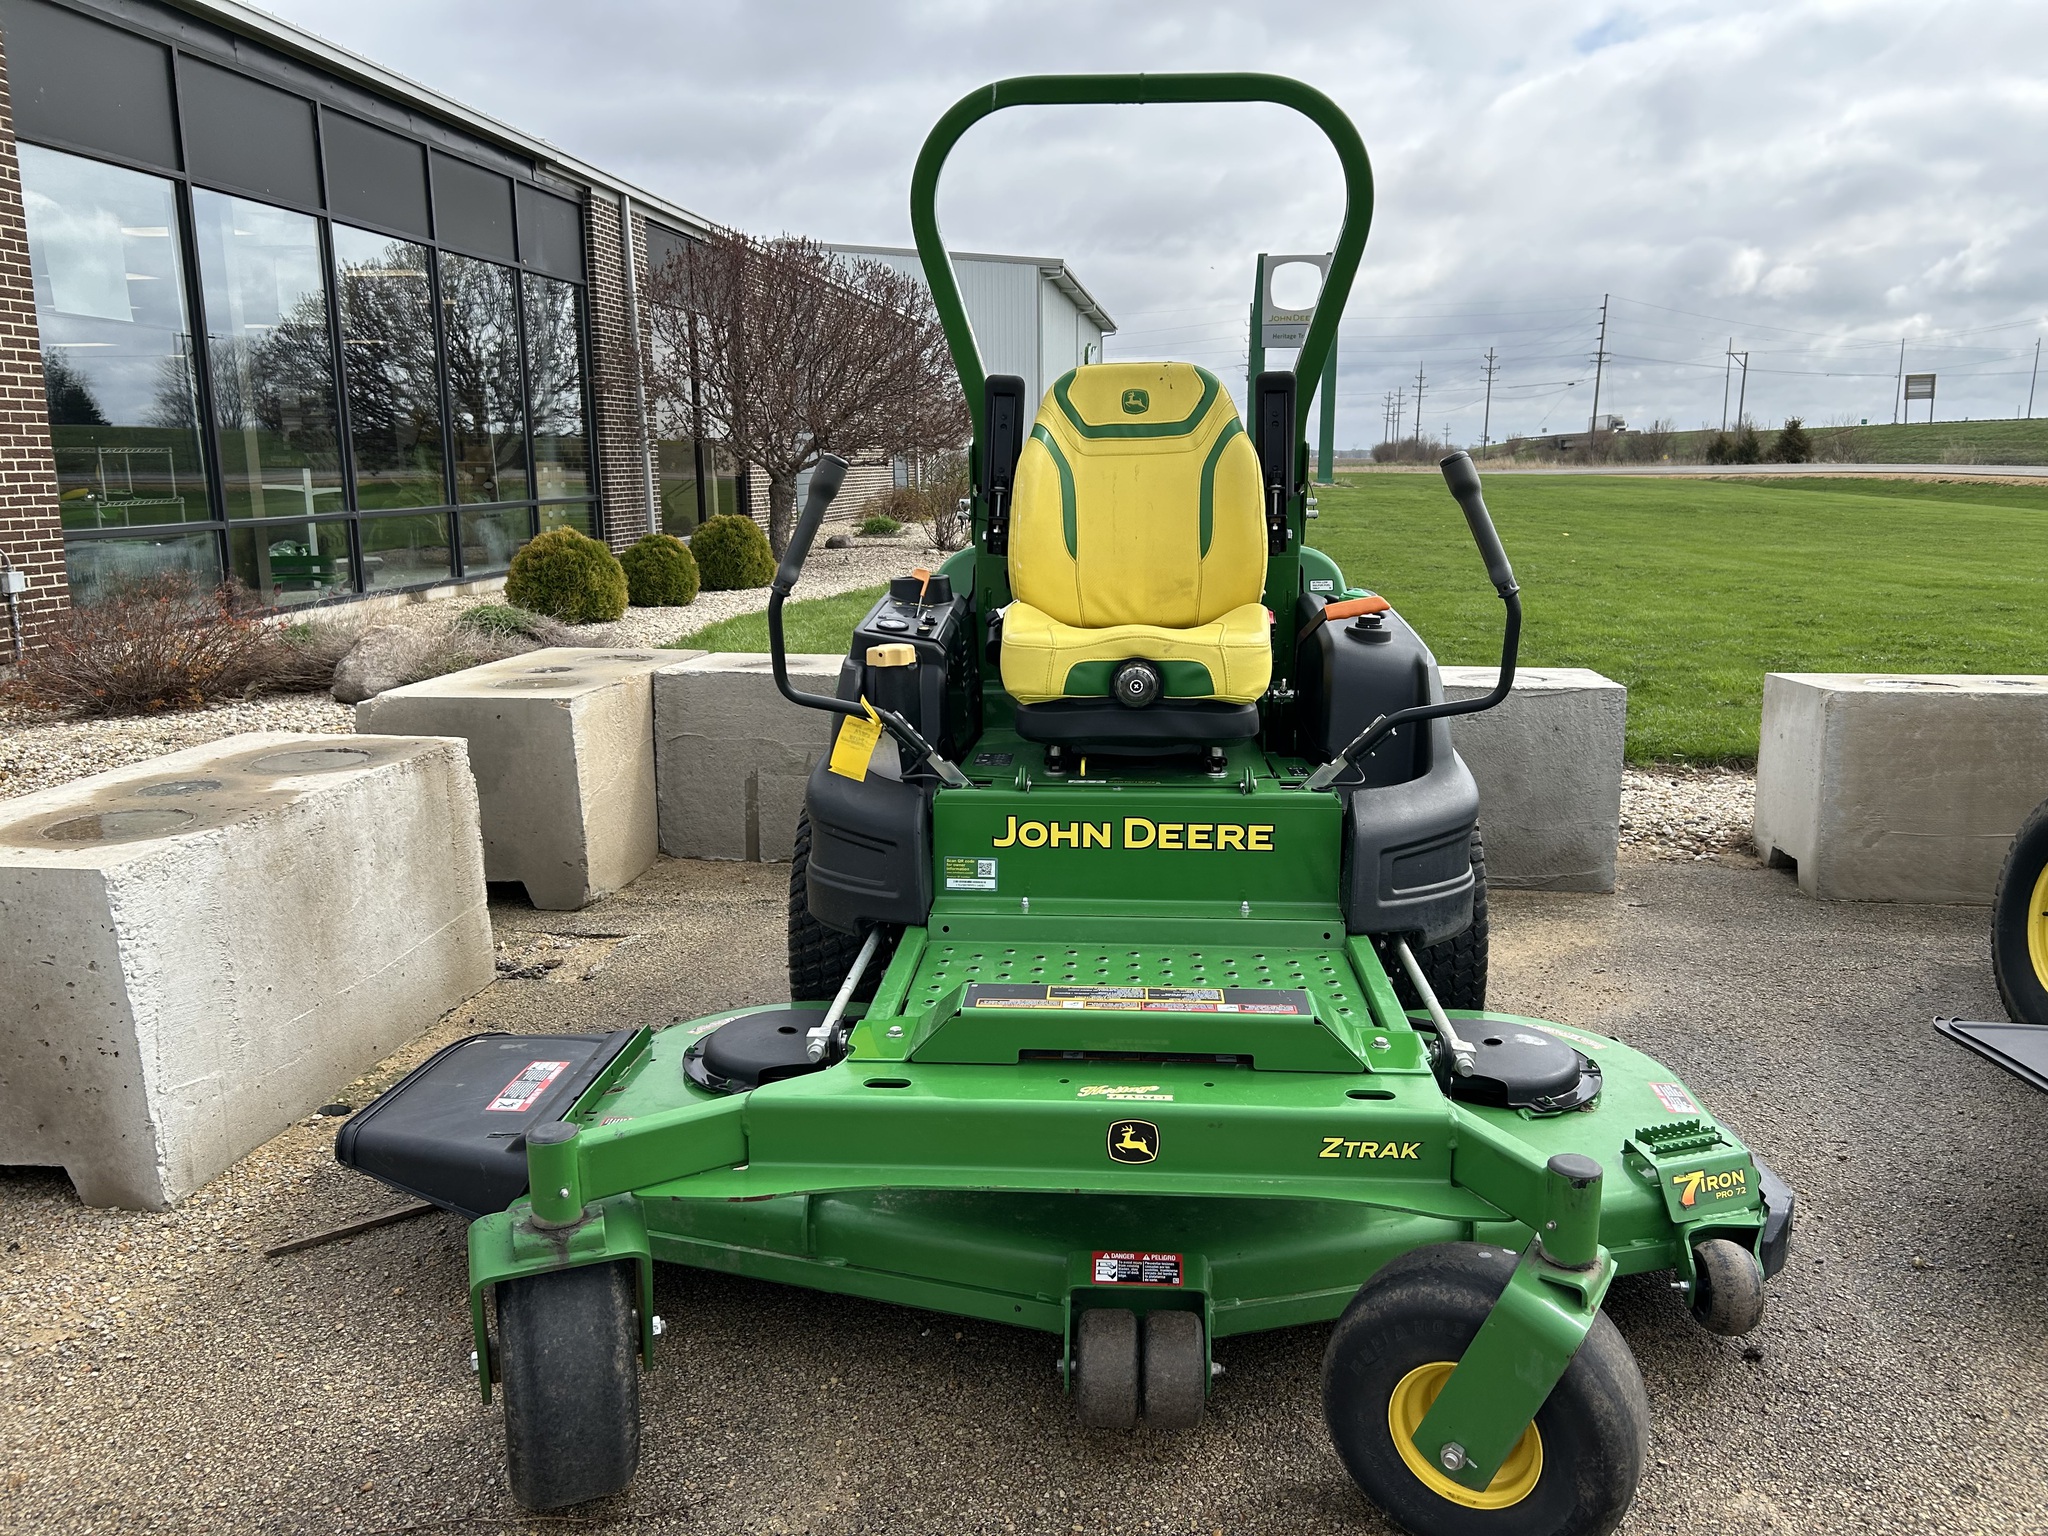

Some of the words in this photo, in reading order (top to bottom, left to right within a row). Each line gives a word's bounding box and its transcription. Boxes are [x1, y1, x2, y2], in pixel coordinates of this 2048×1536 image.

[1293, 314, 1311, 322] DEE
[992, 815, 1112, 850] JOHN
[1123, 816, 1275, 851] DEERE
[1318, 1136, 1423, 1159] ZTRAK
[1715, 1190, 1734, 1200] PRO
[1736, 1187, 1747, 1195] 72
